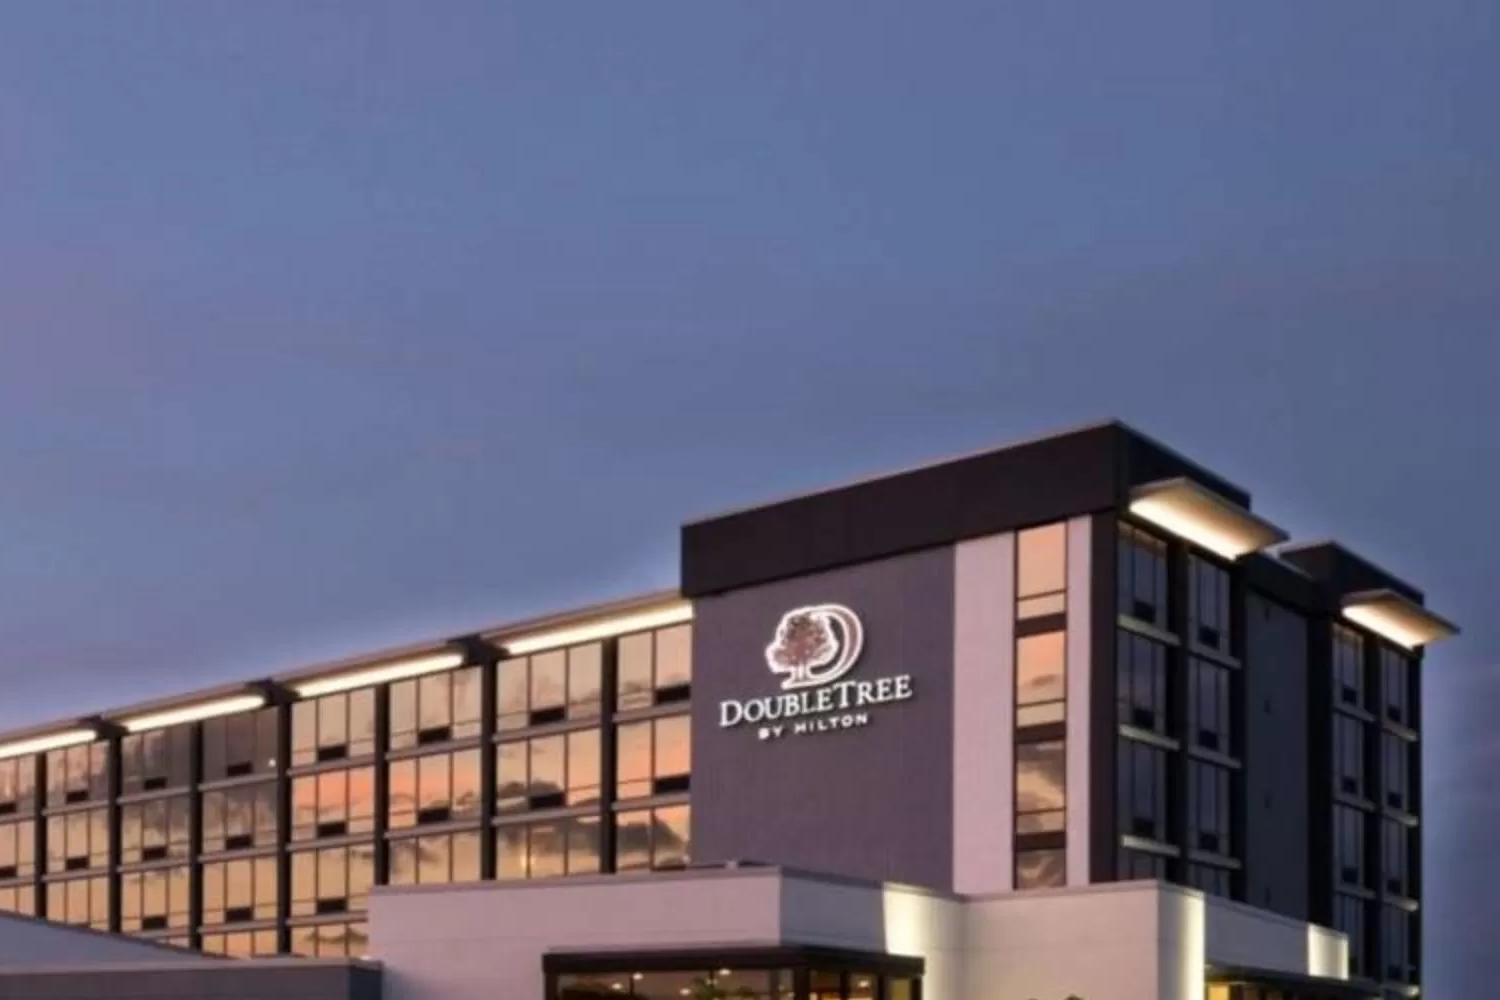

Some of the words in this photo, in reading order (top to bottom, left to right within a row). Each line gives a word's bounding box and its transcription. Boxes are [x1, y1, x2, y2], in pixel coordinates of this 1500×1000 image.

[719, 675, 913, 727] DOUBLETREE
[757, 724, 784, 740] BY
[794, 712, 869, 735] HILTON
